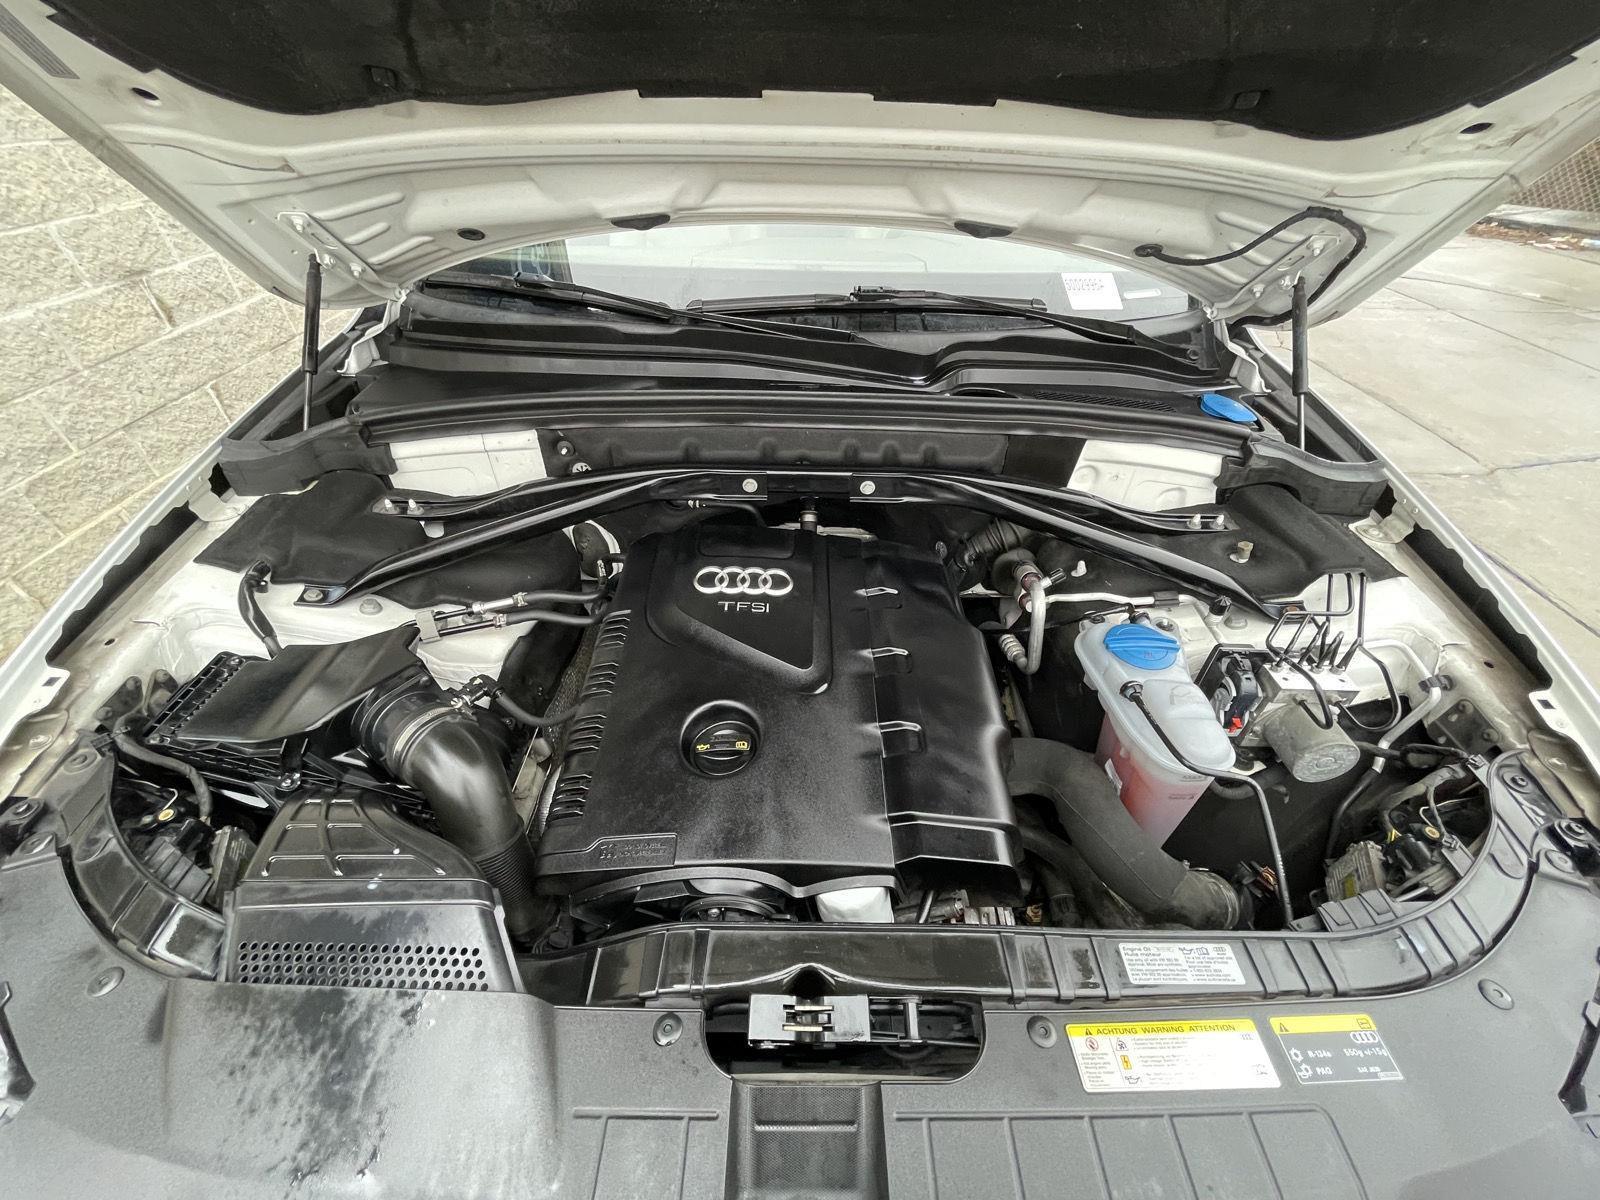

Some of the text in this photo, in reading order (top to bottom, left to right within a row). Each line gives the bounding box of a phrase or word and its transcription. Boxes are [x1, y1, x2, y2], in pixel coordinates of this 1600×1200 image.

[718, 601, 770, 613] TFSI
[1096, 1023, 1236, 1036] ACHTUNG WARNING ATTENTION
